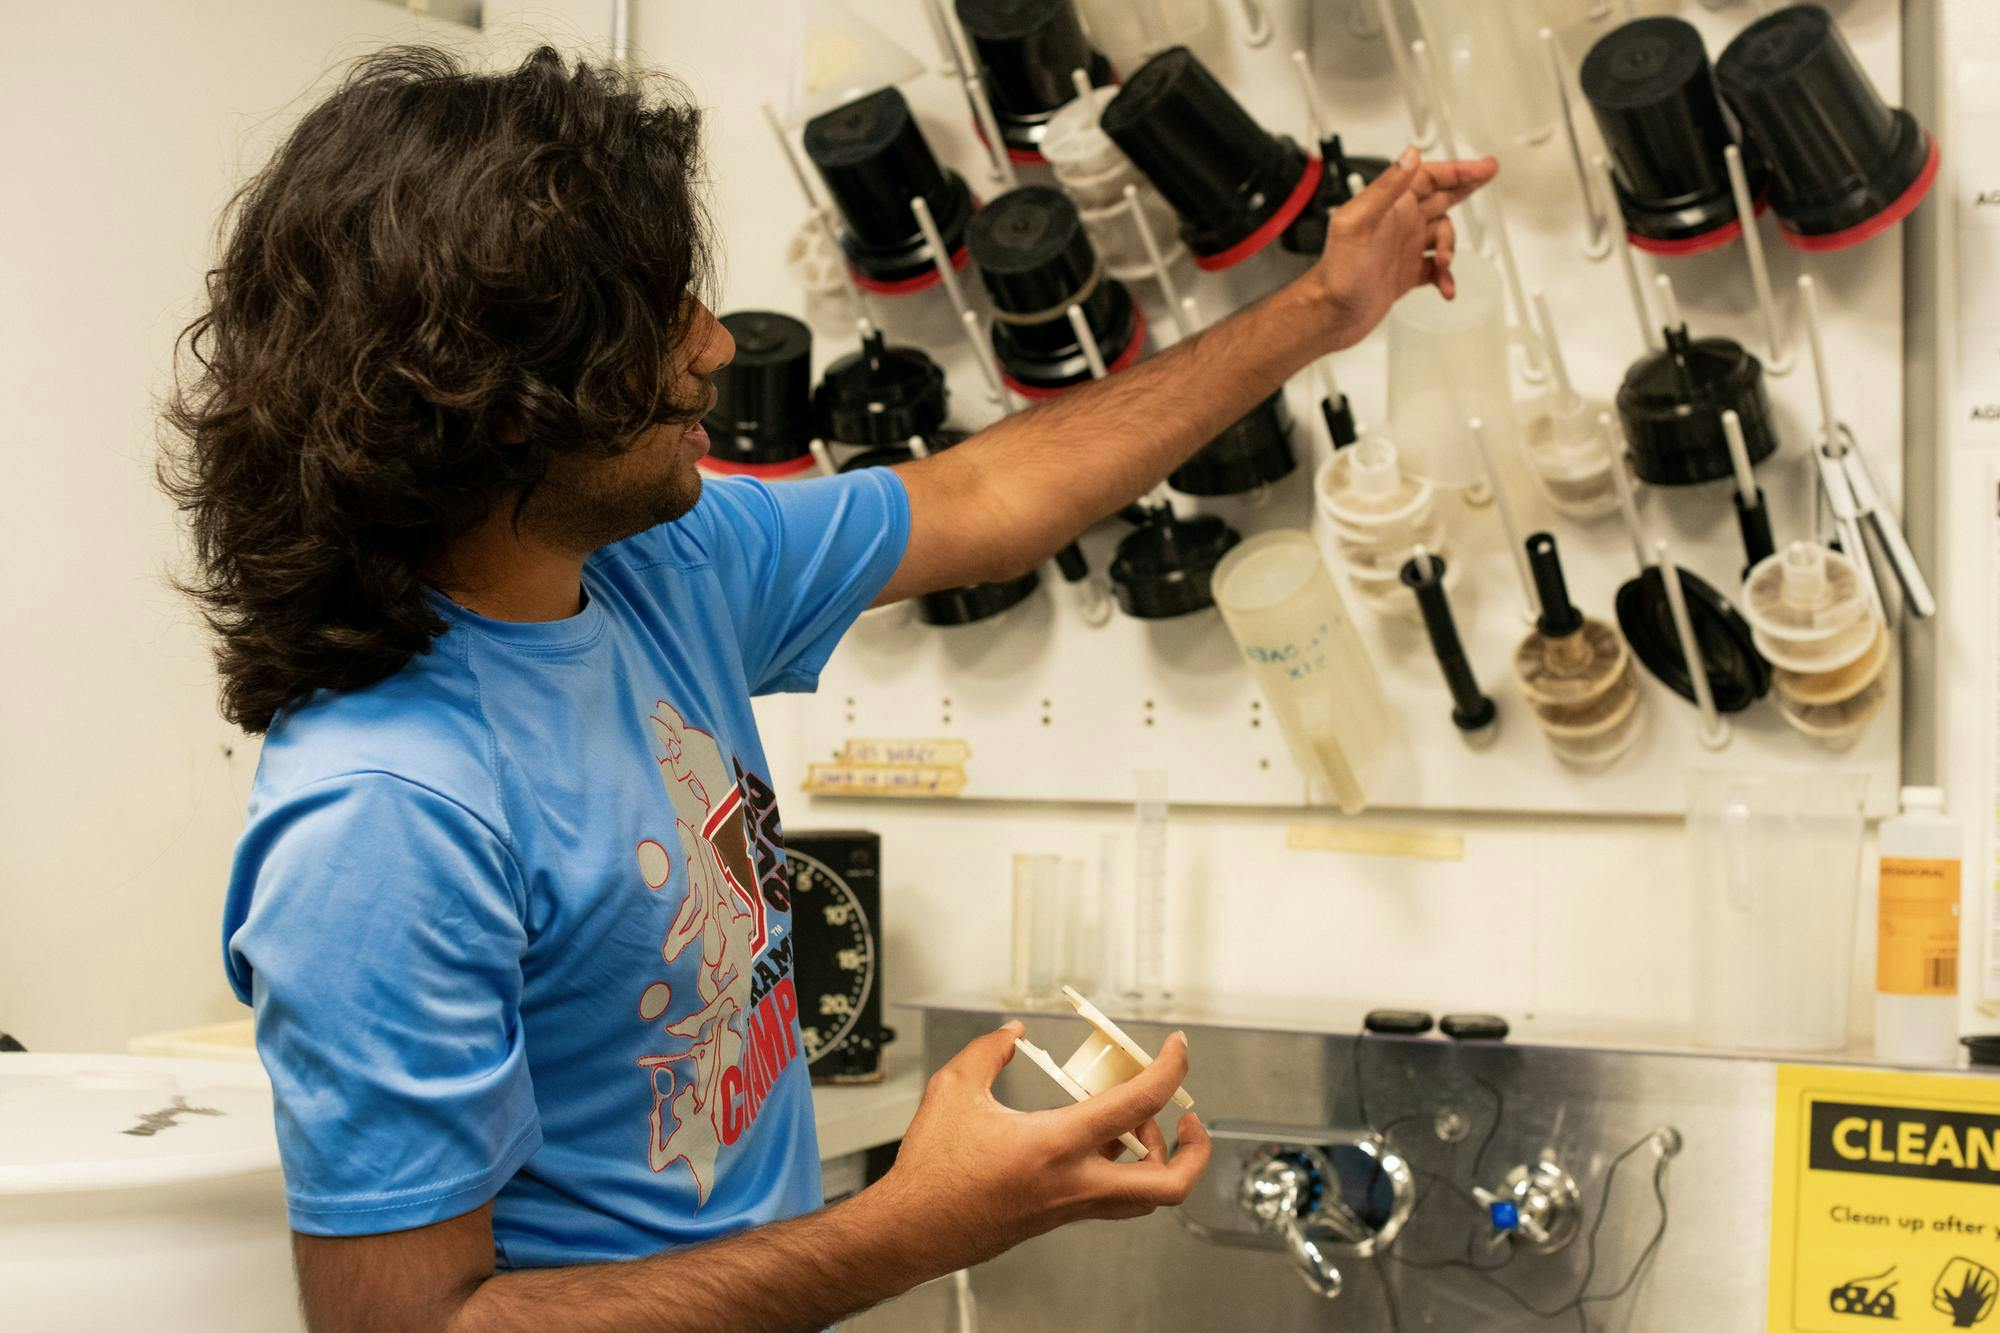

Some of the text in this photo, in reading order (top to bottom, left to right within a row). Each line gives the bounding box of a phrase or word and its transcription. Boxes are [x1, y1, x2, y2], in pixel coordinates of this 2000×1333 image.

[823, 905, 849, 926] 10
[770, 924, 784, 937] TM
[837, 950, 862, 971] 15
[819, 994, 849, 1016] 20
[1831, 1117, 2000, 1172] CLEAN
[1830, 1205, 1890, 1226] Clean
[1898, 1217, 1925, 1235] up
[1931, 1215, 1986, 1235] after
